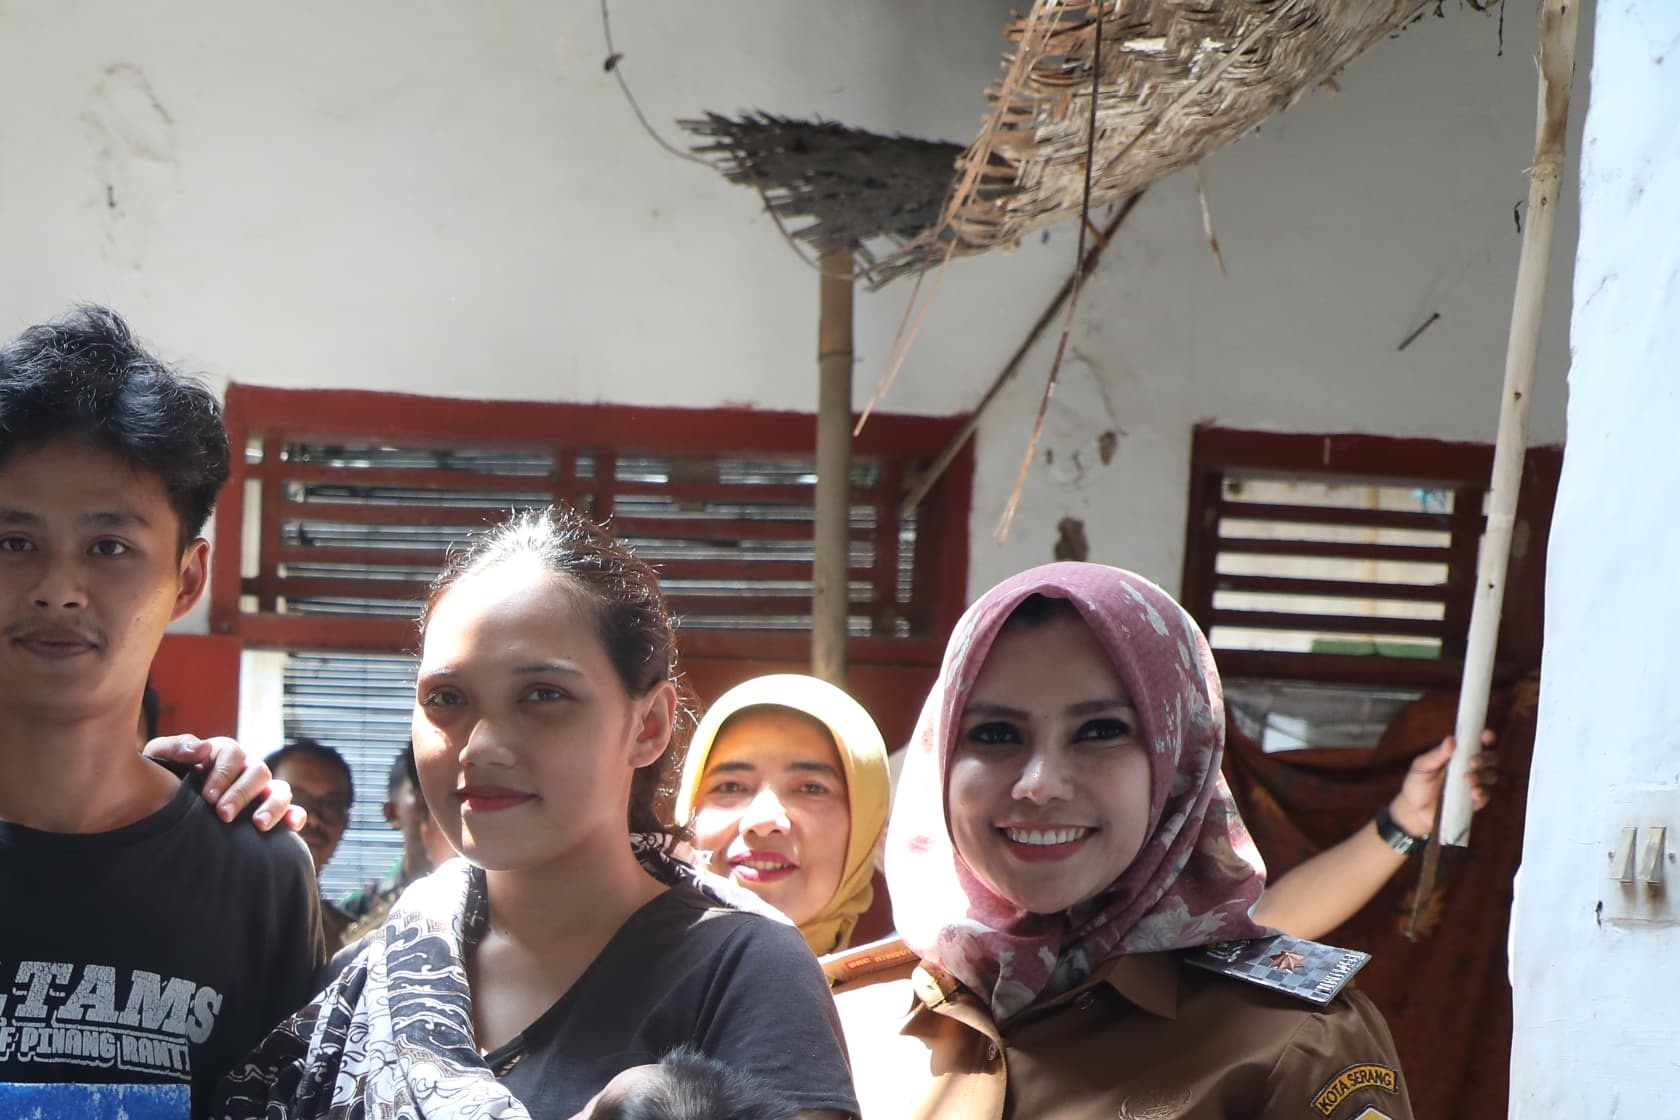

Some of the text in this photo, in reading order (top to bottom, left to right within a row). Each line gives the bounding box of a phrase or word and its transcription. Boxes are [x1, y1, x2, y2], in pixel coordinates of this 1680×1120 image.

[20, 1027, 116, 1058] PINANG
[1319, 1069, 1392, 1112] KOTA SERANG
